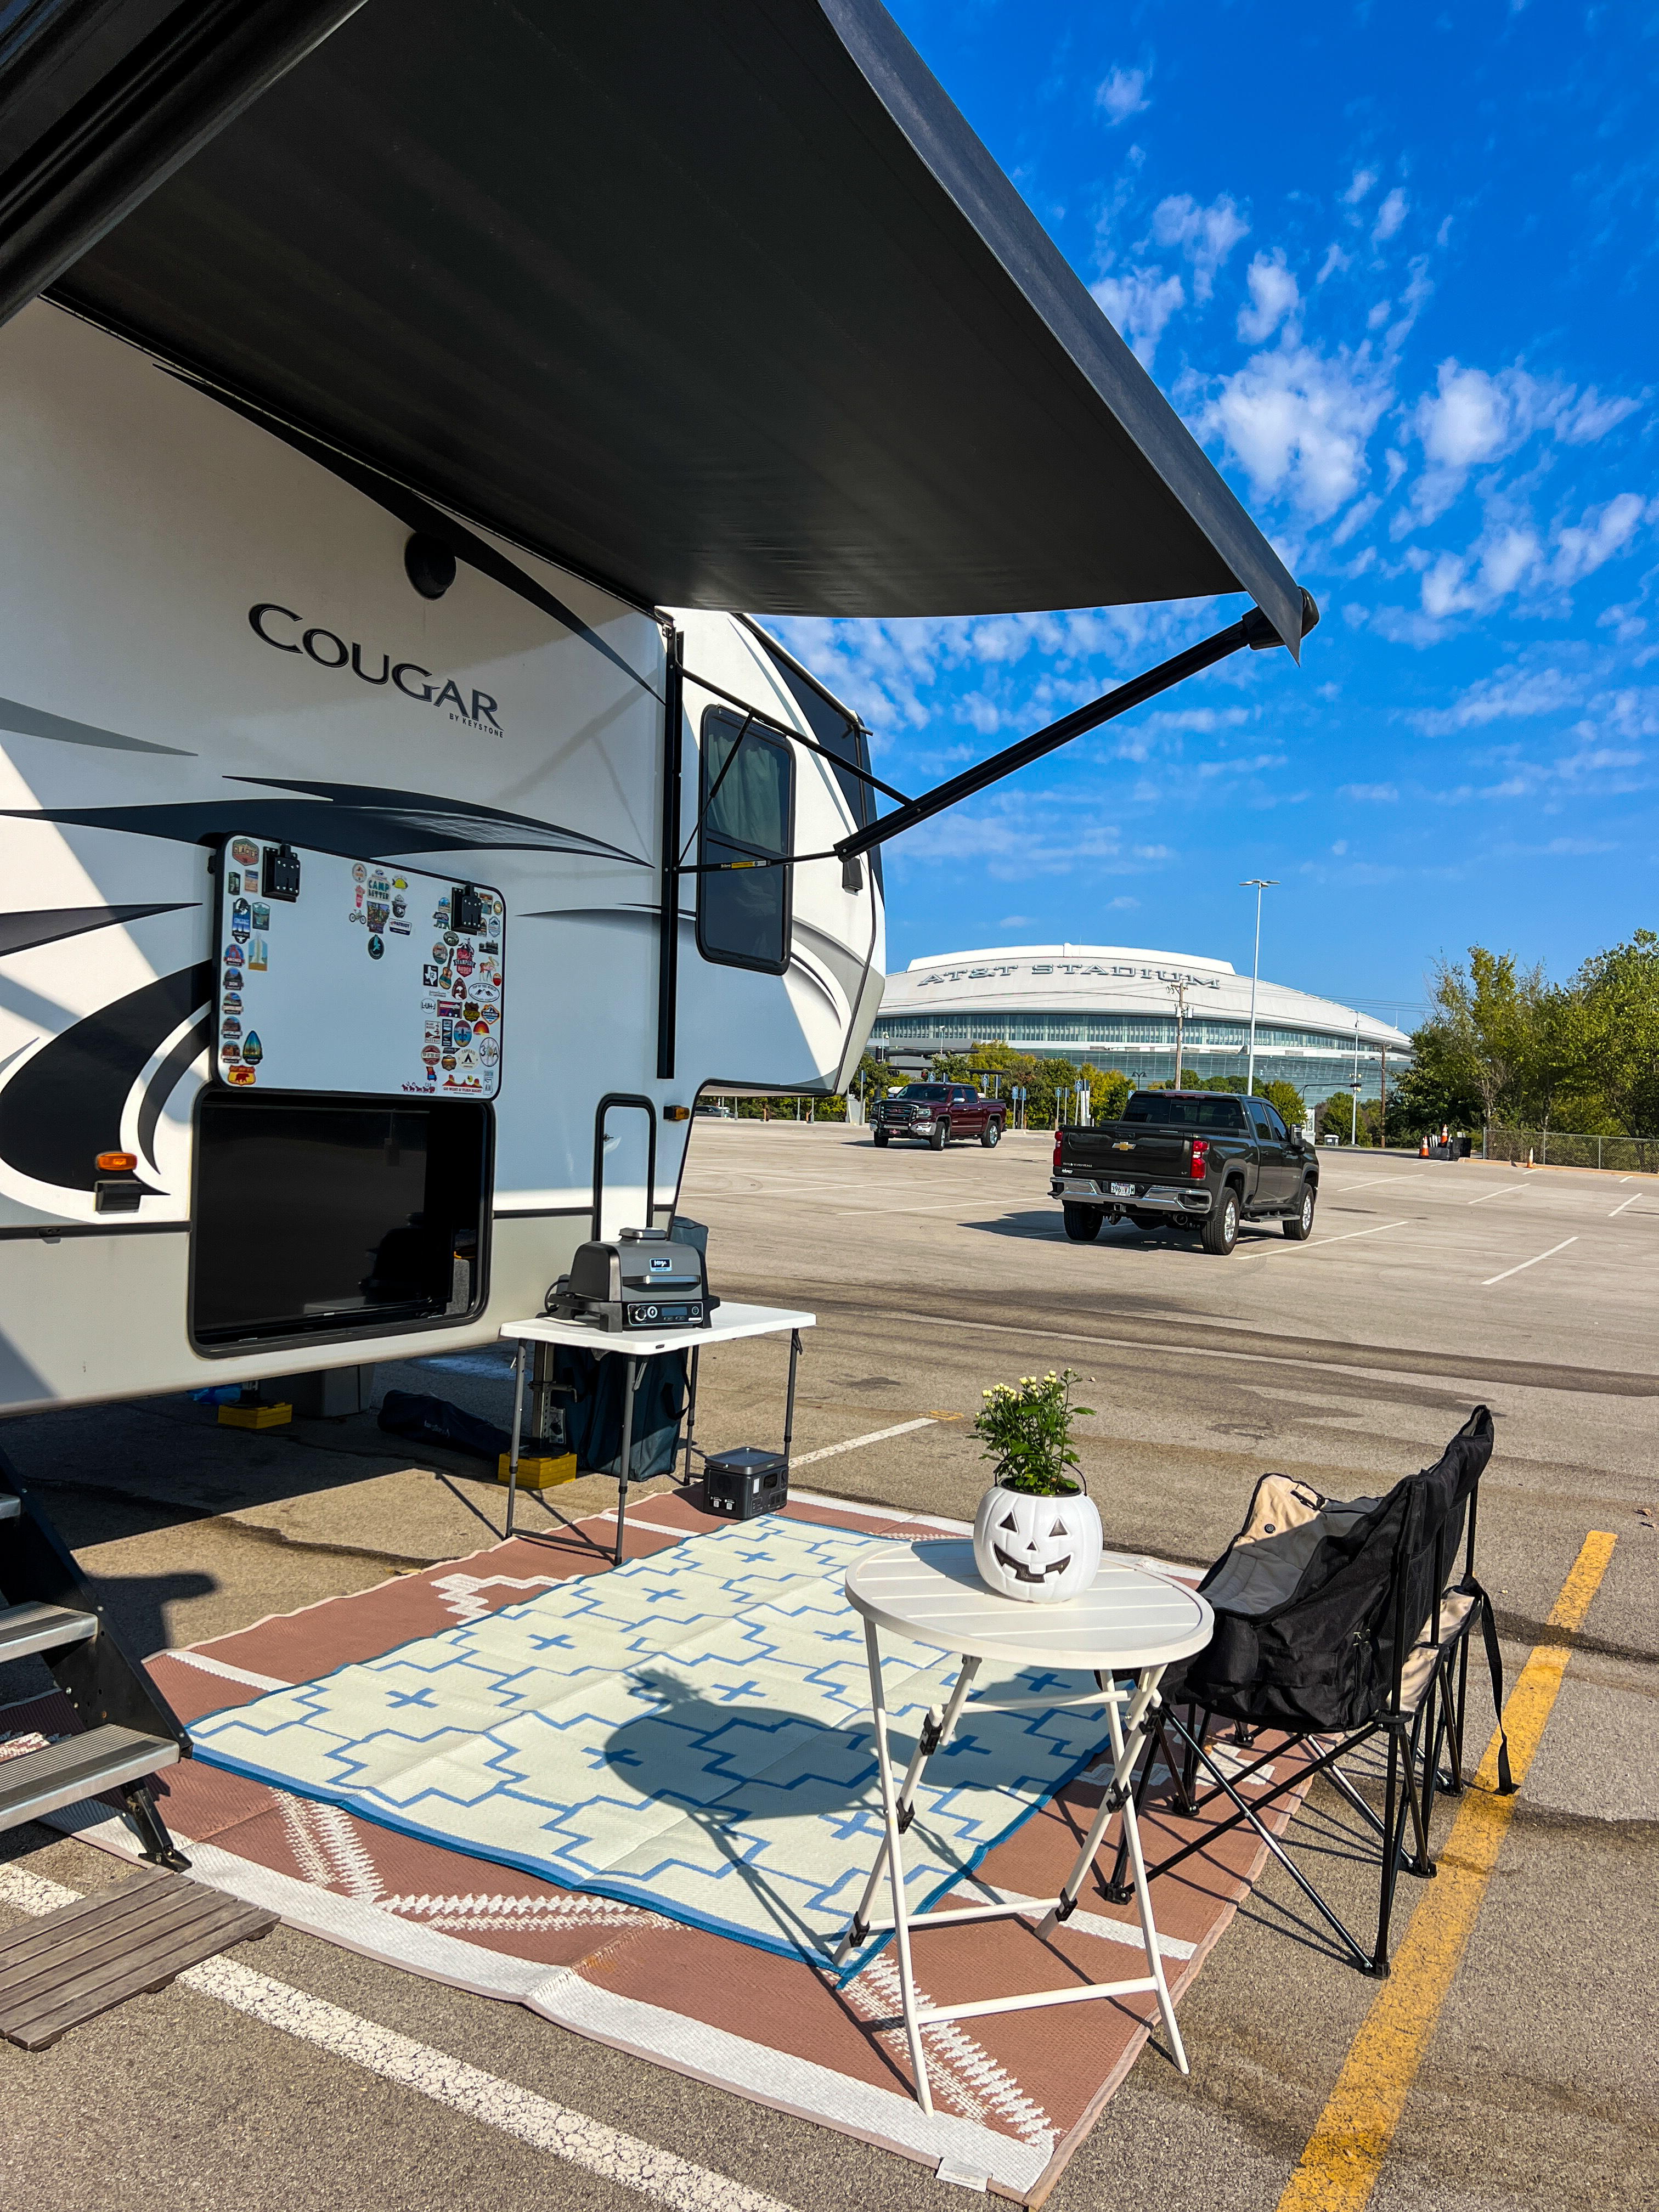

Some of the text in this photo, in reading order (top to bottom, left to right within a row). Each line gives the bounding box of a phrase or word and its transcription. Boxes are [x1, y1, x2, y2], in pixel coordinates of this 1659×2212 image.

[248, 603, 504, 731] COUGAR
[449, 713, 504, 738] BY KEYSTONE
[368, 879, 390, 892] CAMP
[368, 889, 389, 900] BETTER
[917, 964, 1221, 989] AT&T STADIUM
